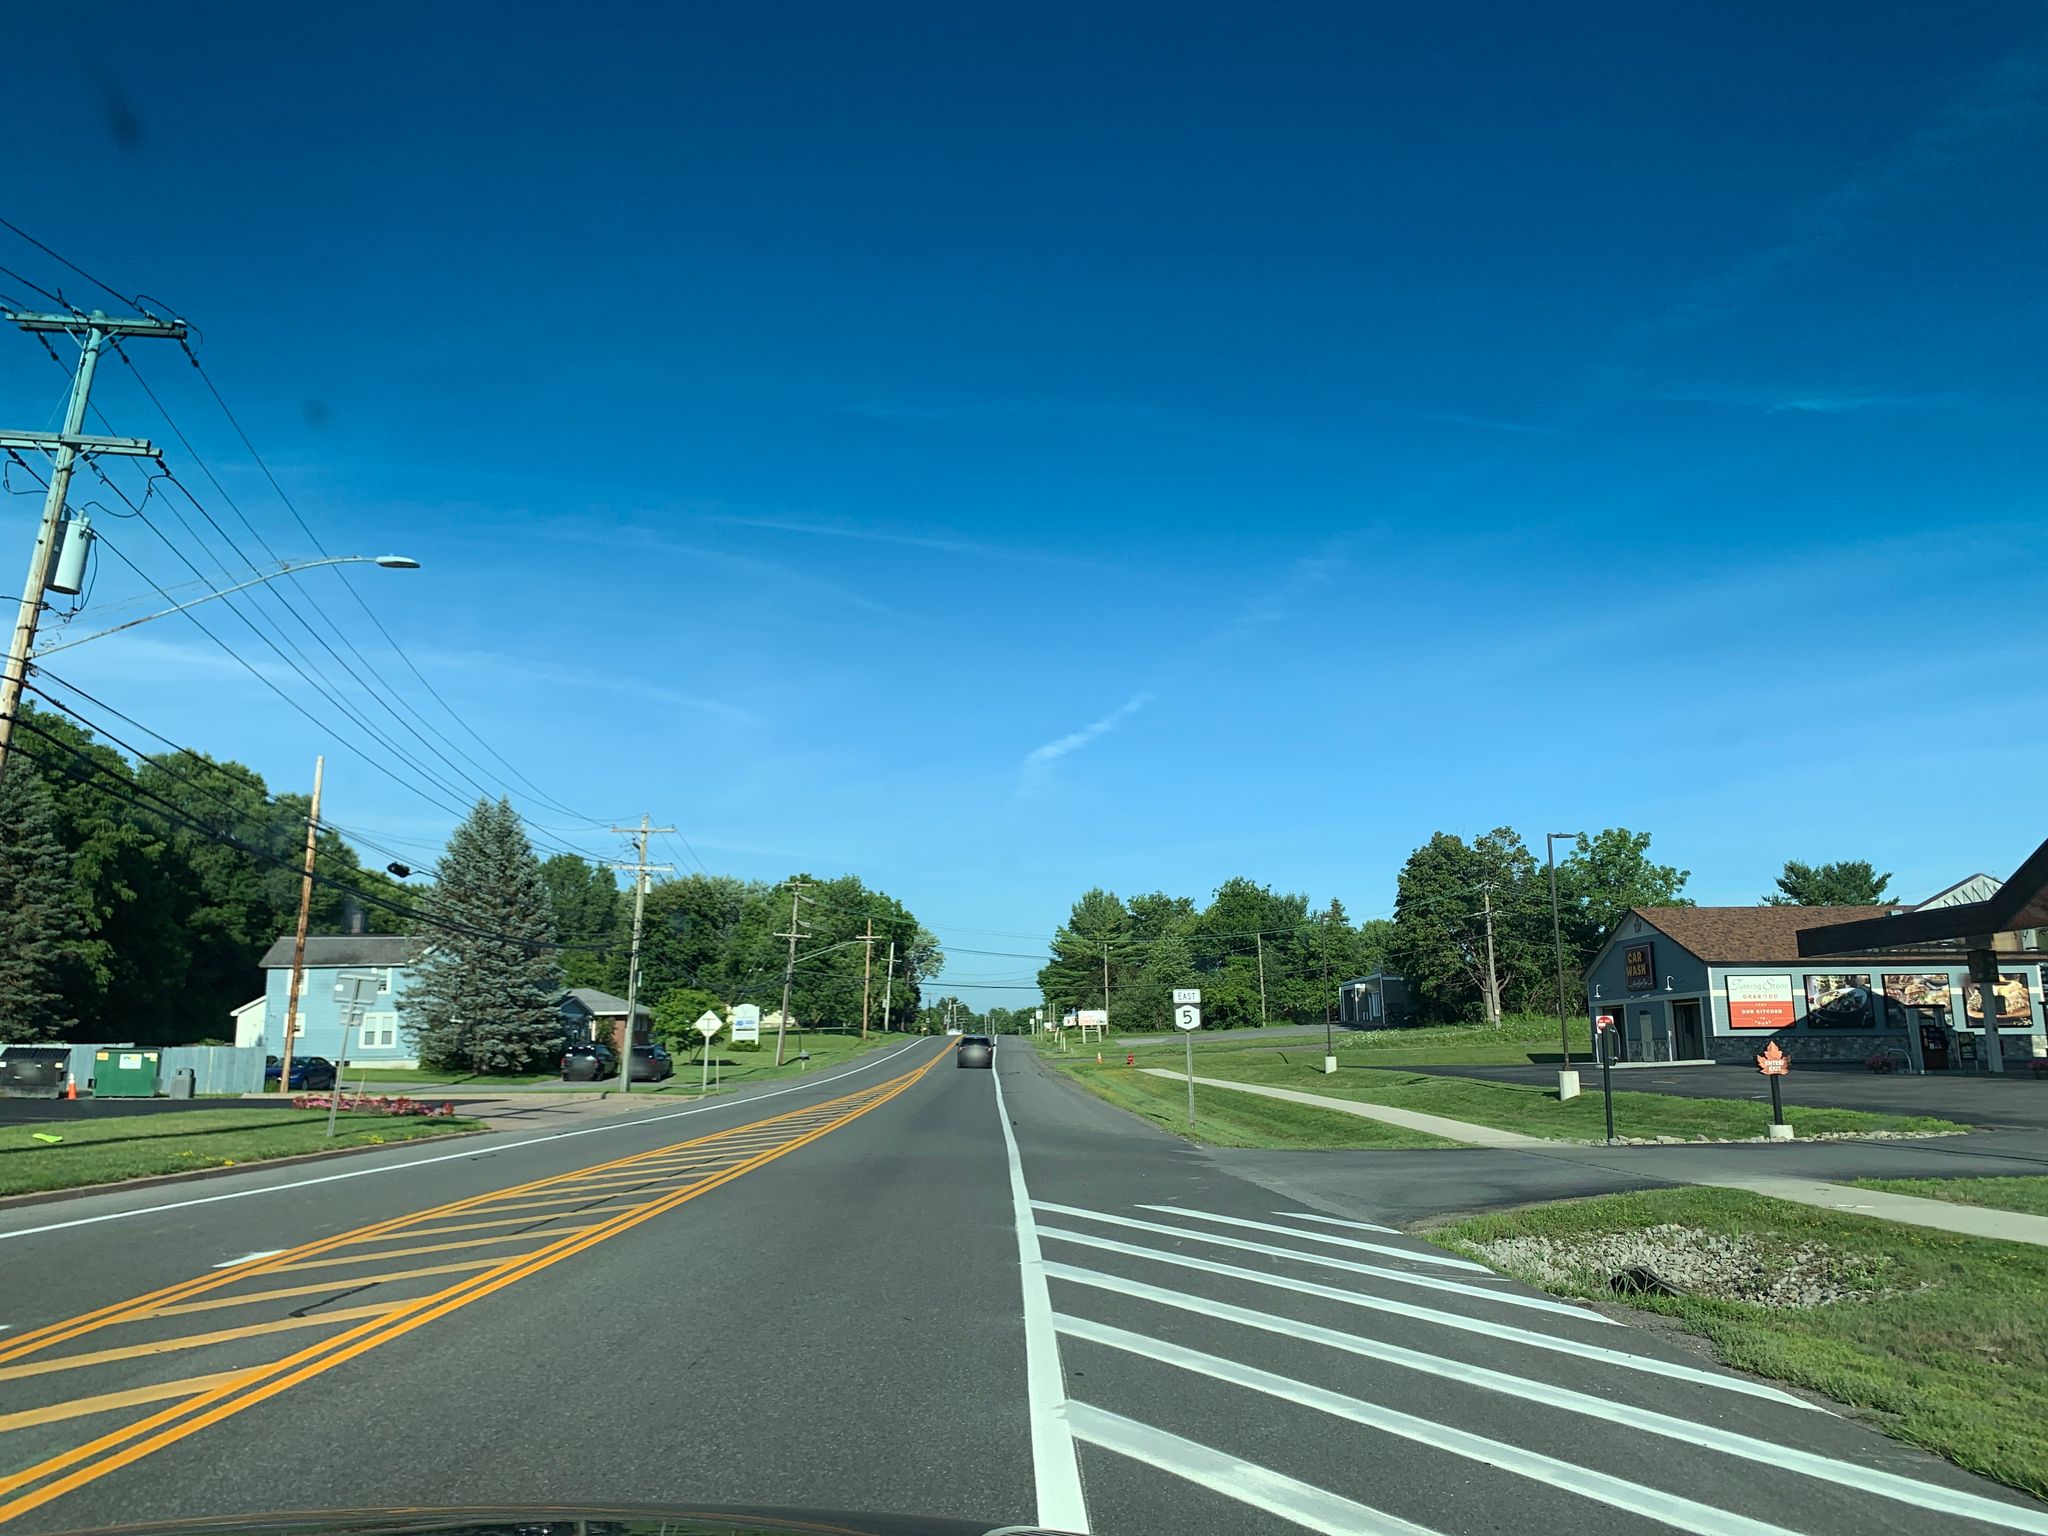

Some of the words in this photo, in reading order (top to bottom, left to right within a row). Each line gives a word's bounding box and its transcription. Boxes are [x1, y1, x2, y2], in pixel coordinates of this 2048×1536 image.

[1627, 951, 1642, 963] CAR
[1626, 963, 1647, 976] WASH
[1730, 979, 1762, 990] Turning
[1763, 978, 1788, 990] Stone
[1178, 992, 1195, 1000] EAST
[1183, 1010, 1193, 1024] 5
